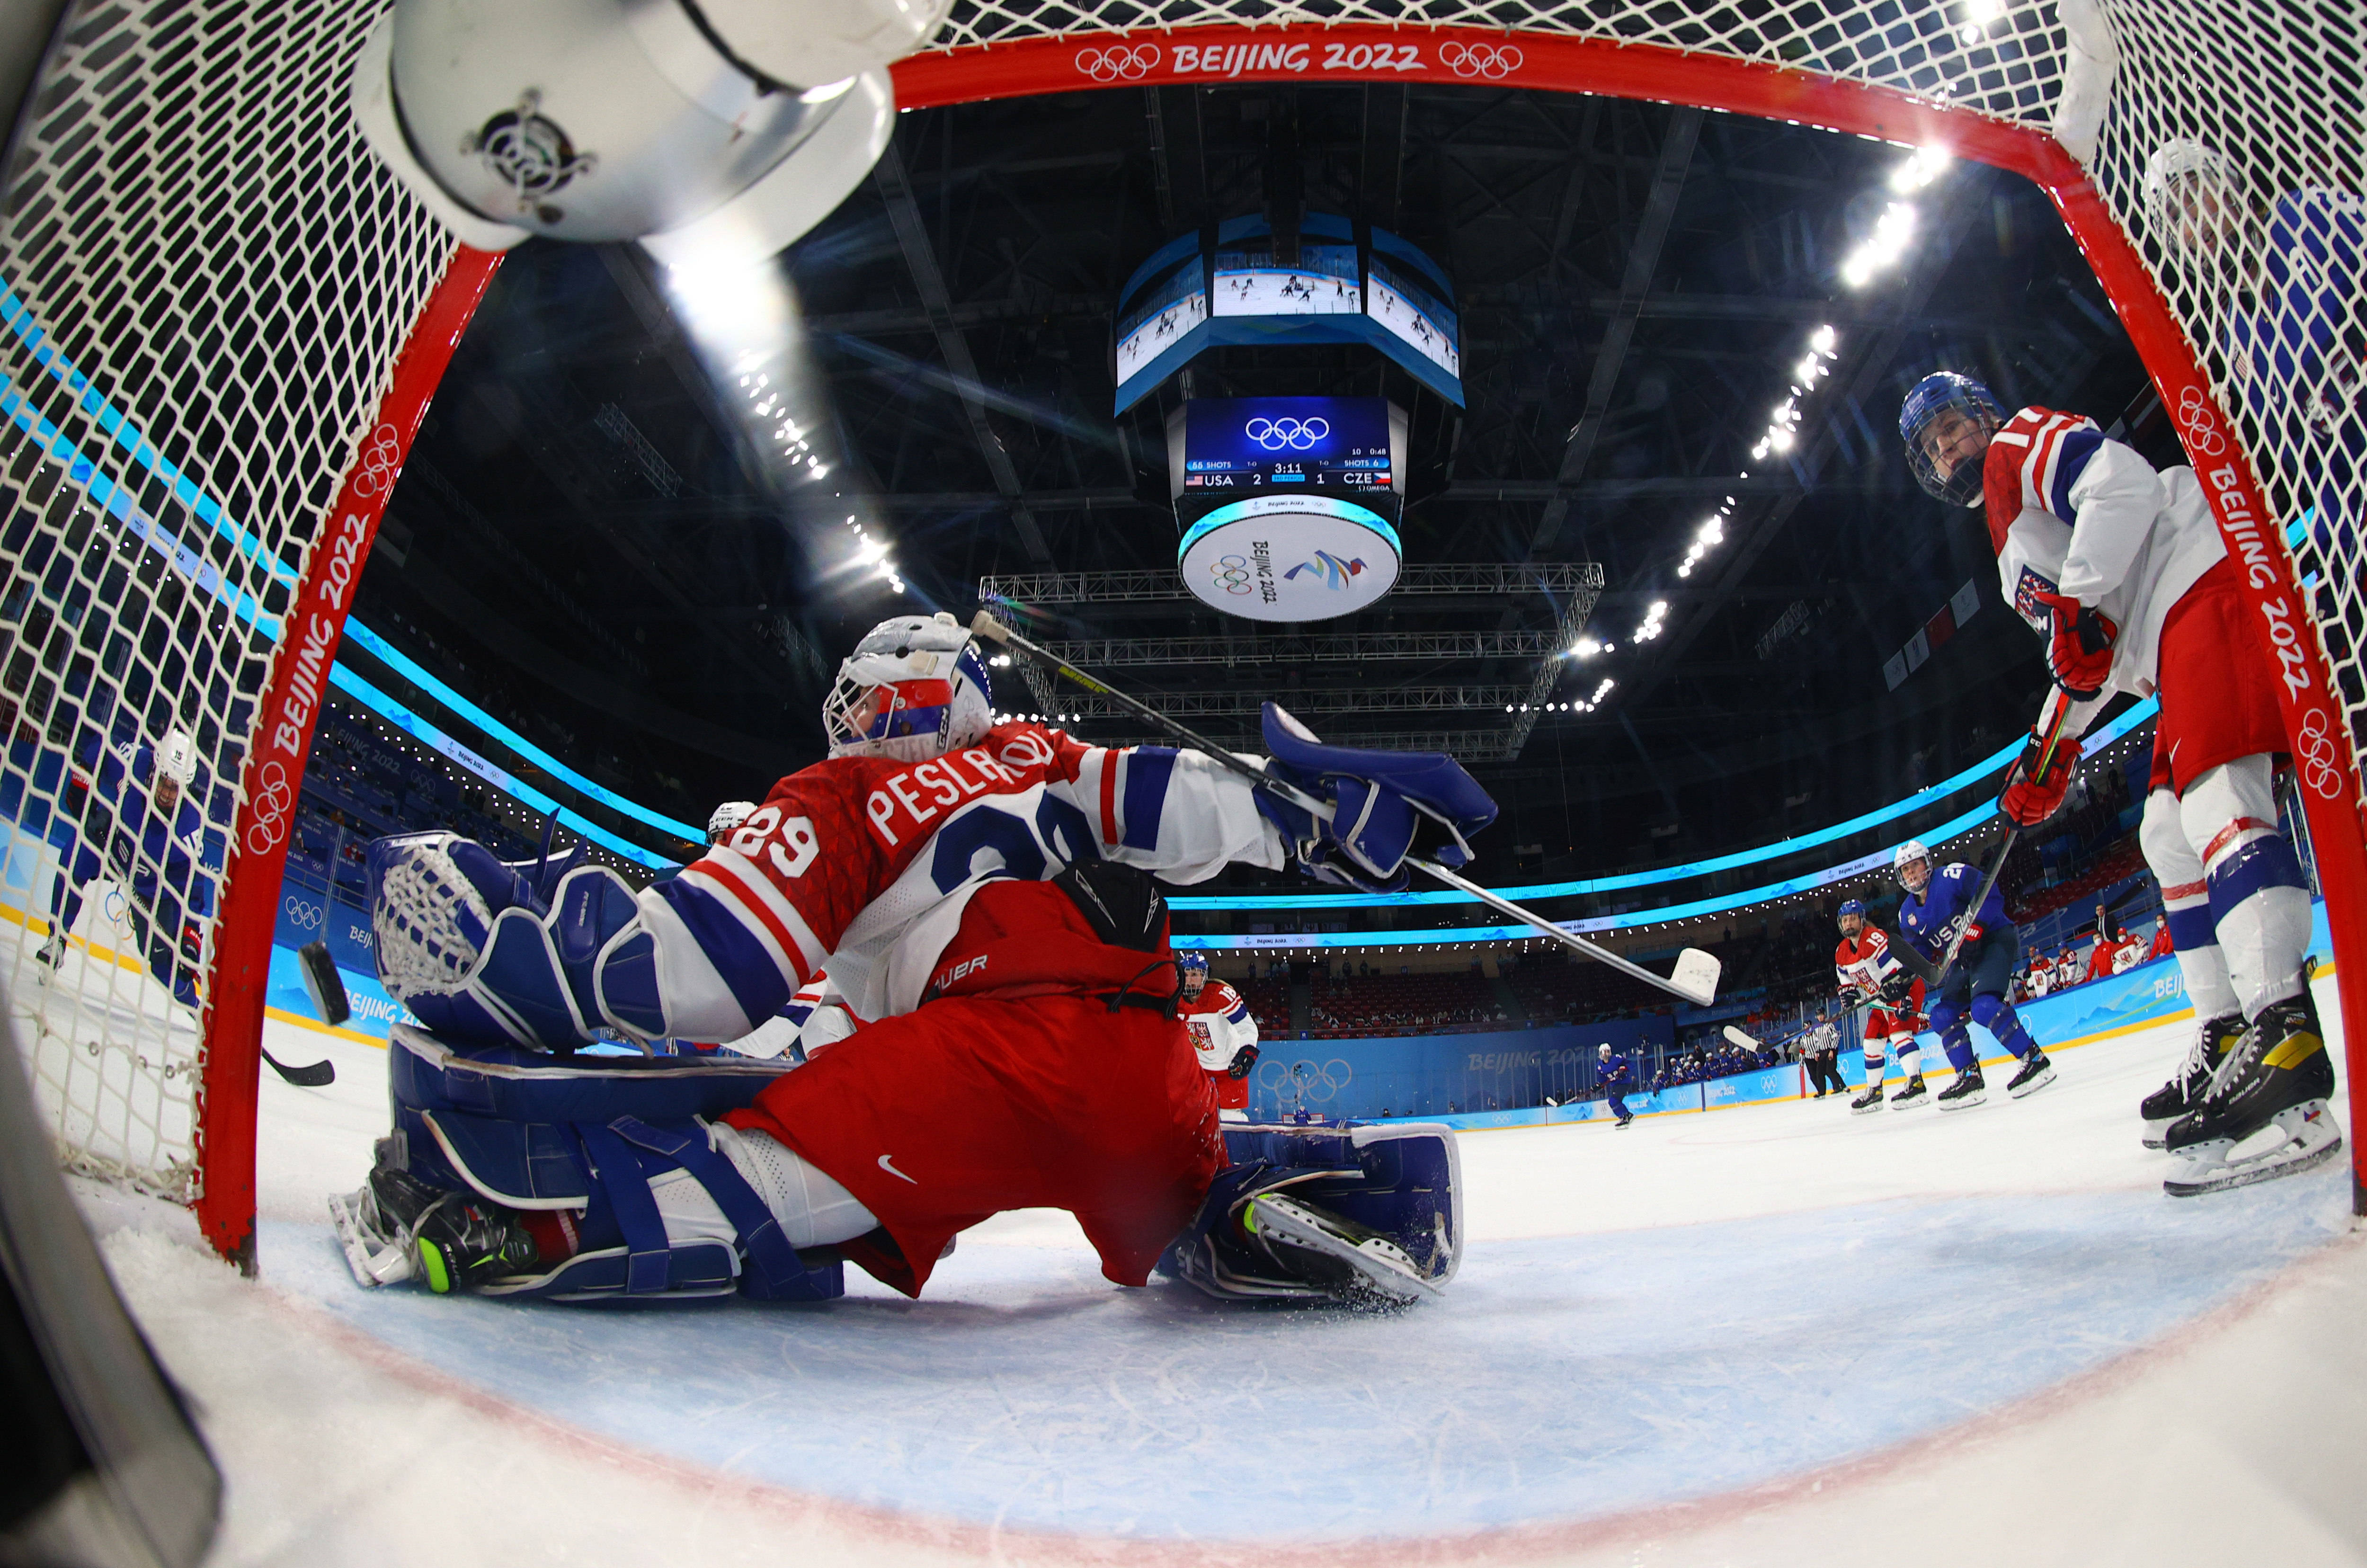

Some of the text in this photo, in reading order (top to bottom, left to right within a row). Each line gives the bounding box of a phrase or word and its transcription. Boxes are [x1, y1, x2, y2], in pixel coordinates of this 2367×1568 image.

[1172, 43, 1427, 78] BEIJING 2022
[1274, 463, 1302, 473] 3:11
[1373, 459, 1379, 467] 6
[1205, 474, 1262, 486] USA 2
[1317, 472, 1372, 484] 1 CZE
[1250, 540, 1277, 604] BEIJING 2022
[2209, 463, 2311, 705] BEIJING 2022
[275, 513, 371, 757] BEIJING 2022
[175, 750, 182, 761] 15
[729, 806, 820, 878] 29
[1866, 932, 1885, 947] 19
[1219, 986, 1237, 1002] 18
[1468, 1051, 1541, 1075] BEIJING
